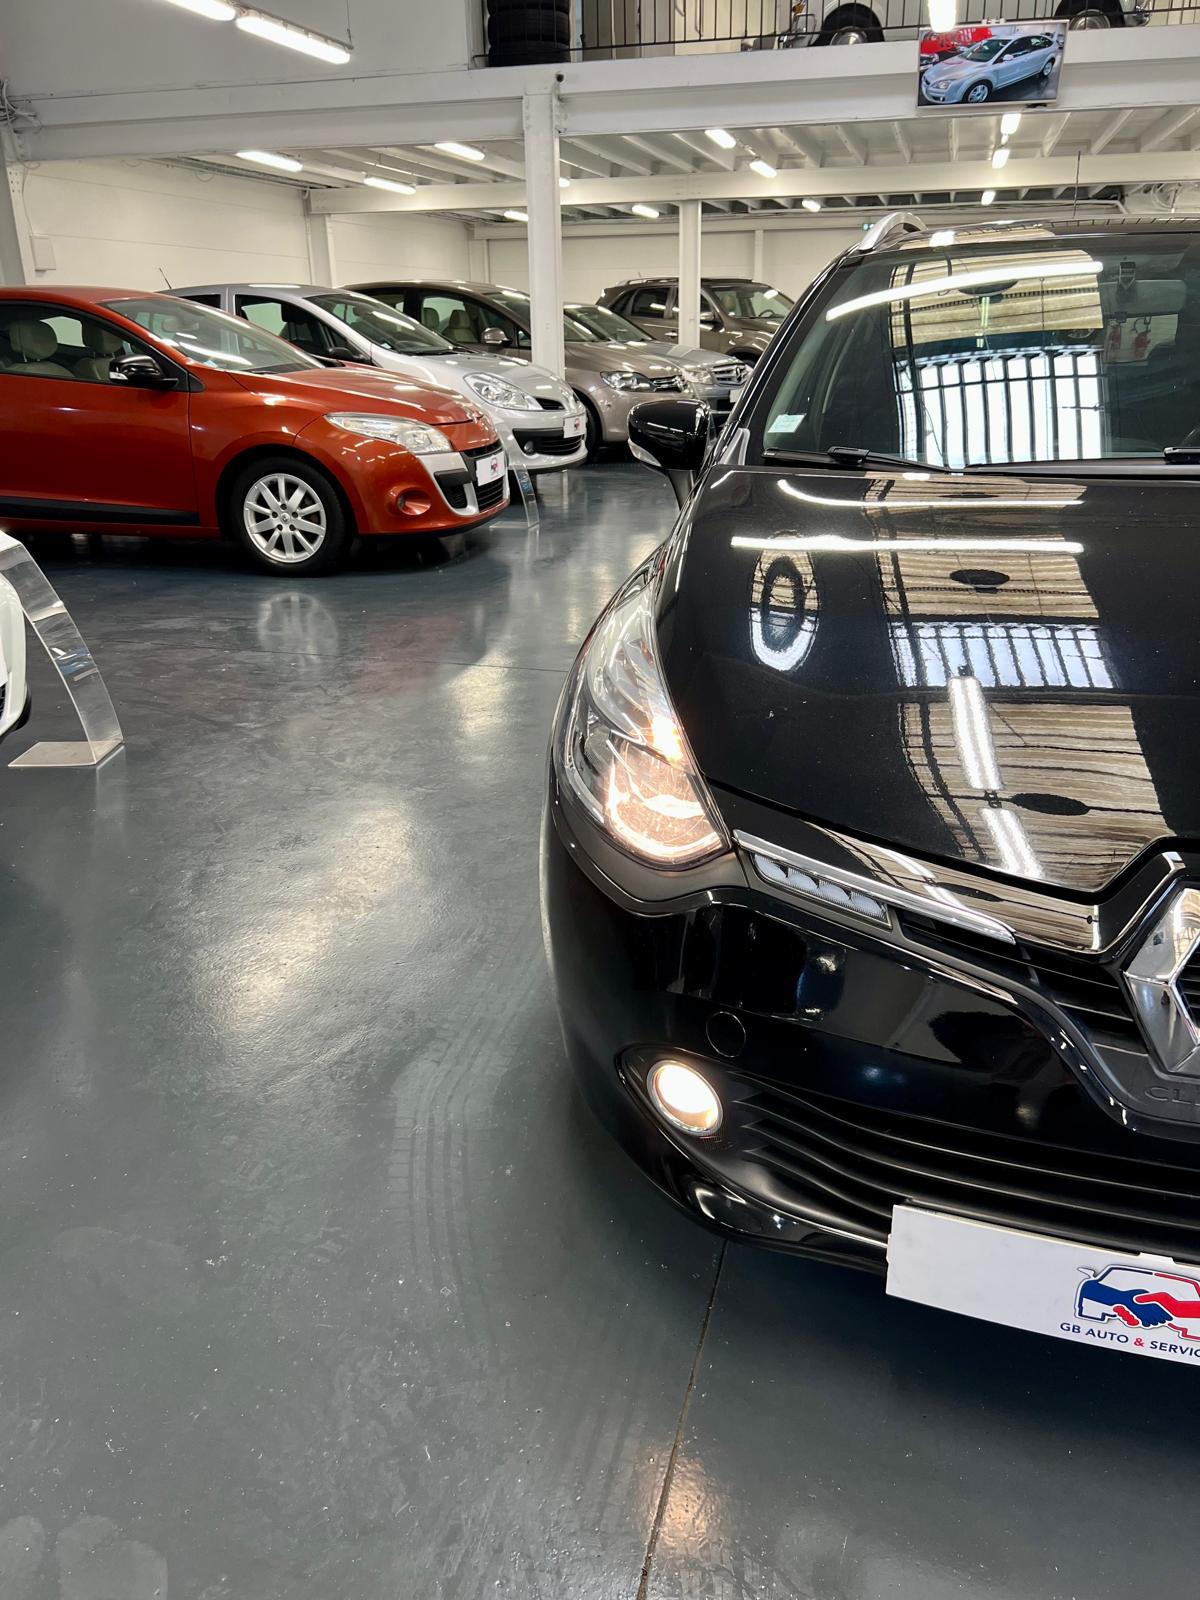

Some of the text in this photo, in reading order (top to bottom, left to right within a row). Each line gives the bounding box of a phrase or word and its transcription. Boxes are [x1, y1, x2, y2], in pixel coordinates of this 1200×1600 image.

[1060, 1322, 1081, 1333] GB
[1085, 1328, 1129, 1343] AUTO
[1133, 1337, 1145, 1347] &
